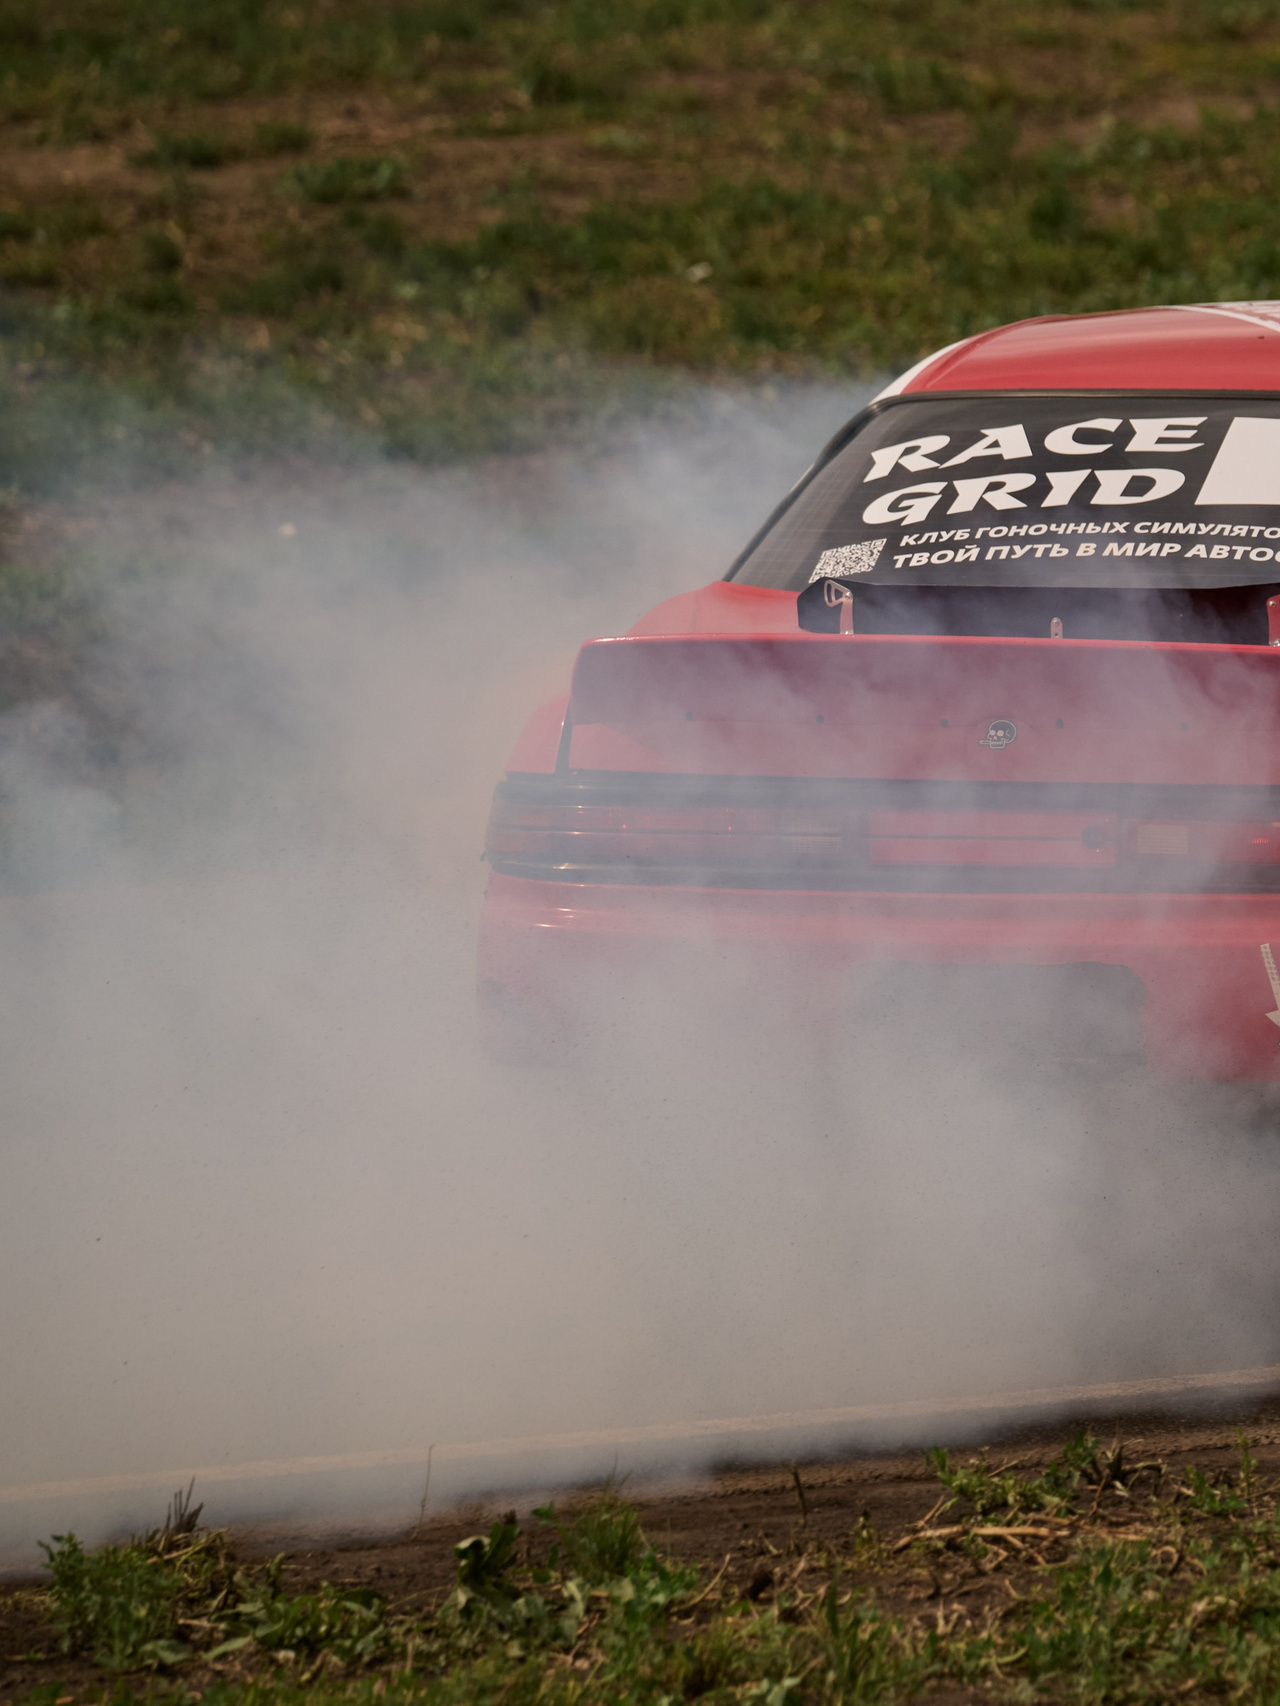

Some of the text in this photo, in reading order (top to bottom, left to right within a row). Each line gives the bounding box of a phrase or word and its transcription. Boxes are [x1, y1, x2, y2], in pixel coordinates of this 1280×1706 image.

[863, 417, 1208, 483] RACE
[862, 468, 1186, 526] GRID
[900, 528, 971, 547] КЛУБ
[974, 521, 1131, 539] ГОНОЧНЫХ
[892, 544, 981, 569] ТВОЙ
[984, 545, 1070, 561] ПУТЬ
[1075, 542, 1098, 557] В
[1101, 542, 1183, 557] МИР
